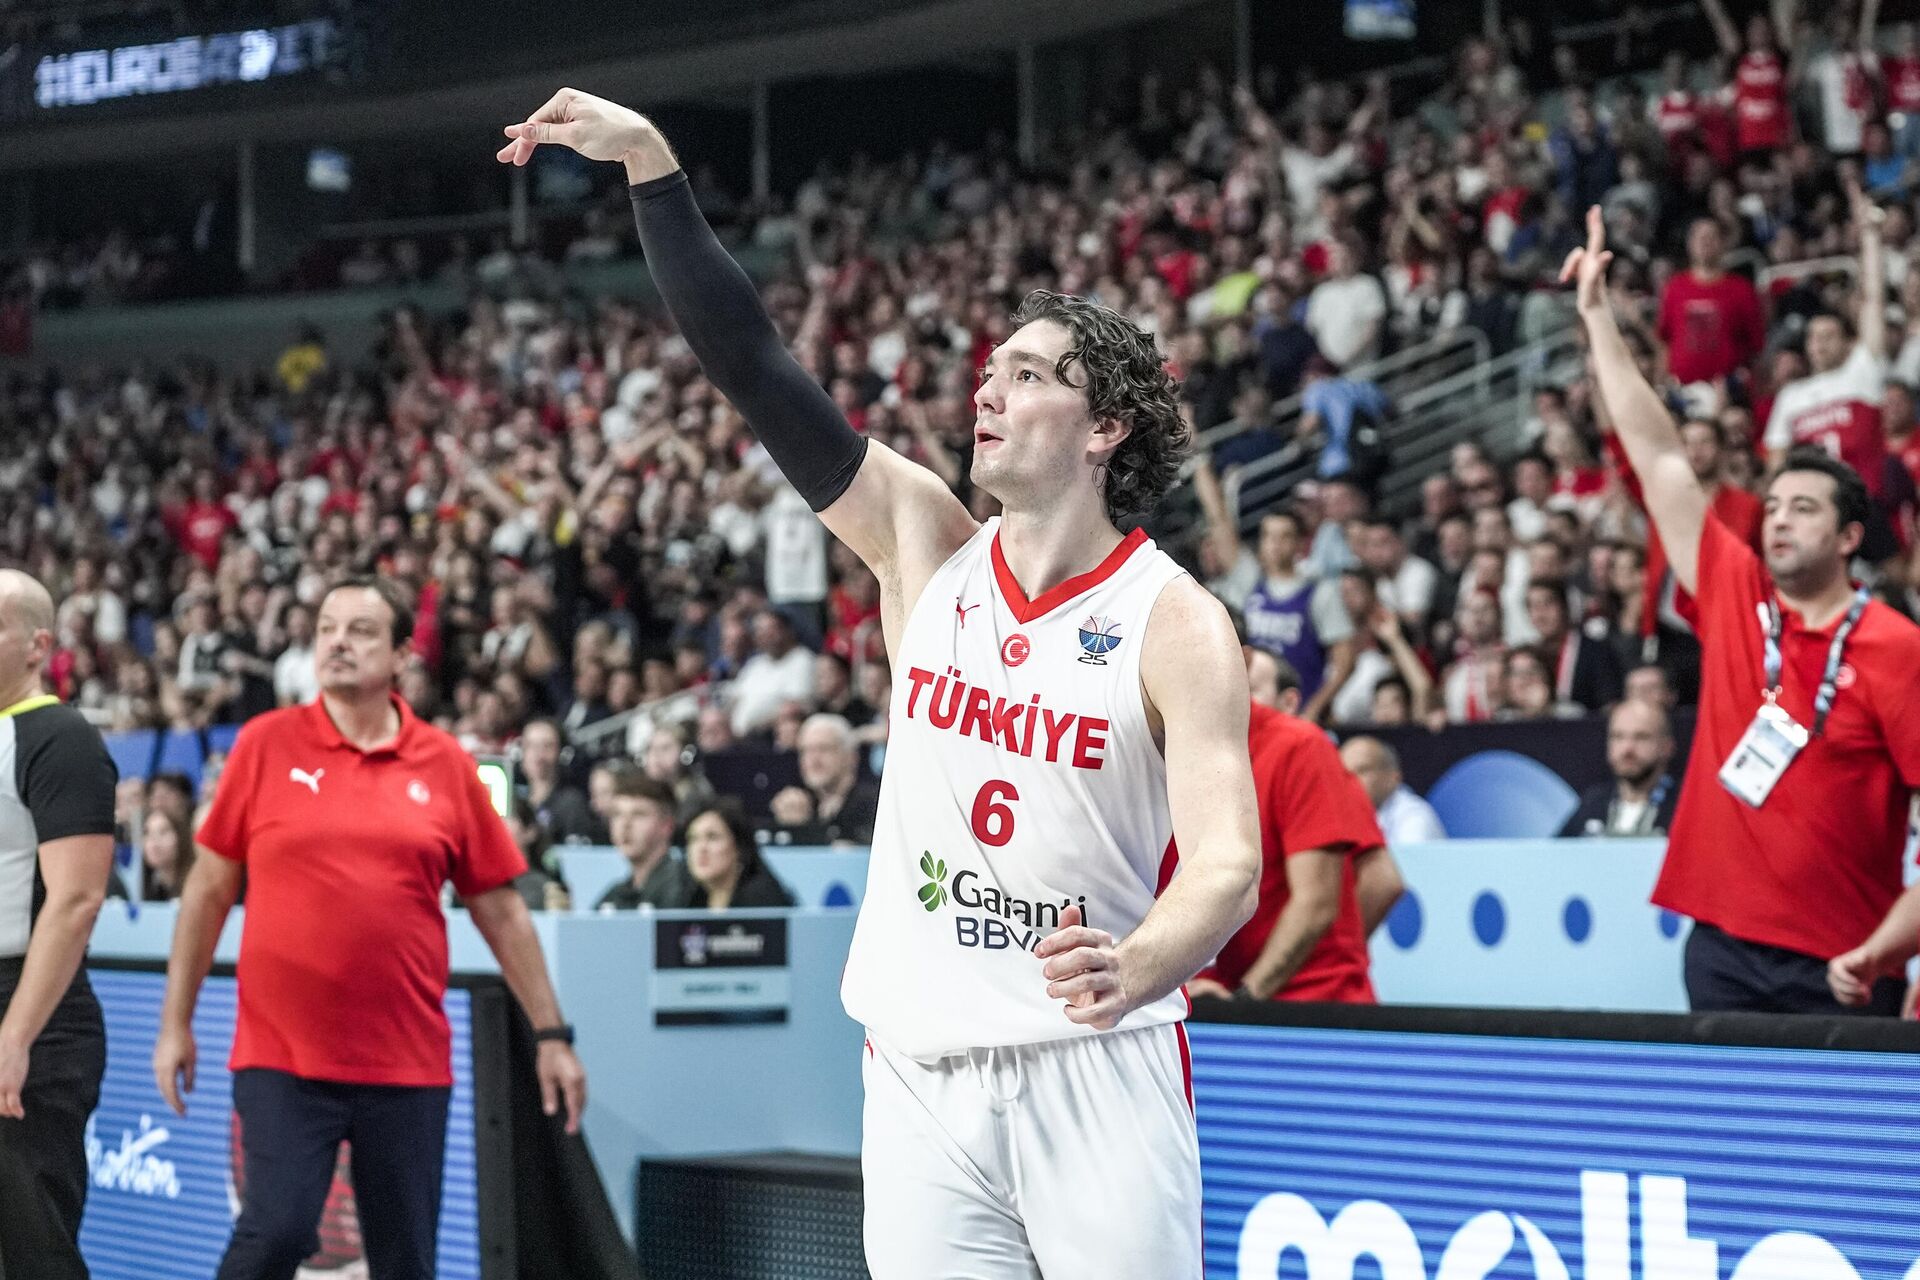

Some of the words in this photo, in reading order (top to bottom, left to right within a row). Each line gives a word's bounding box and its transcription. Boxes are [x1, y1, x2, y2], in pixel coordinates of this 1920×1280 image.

[907, 665, 1110, 770] TÜRKİYE
[971, 779, 1020, 847] 6
[951, 869, 1089, 929] Garani
[1237, 1170, 1920, 1280] molt
